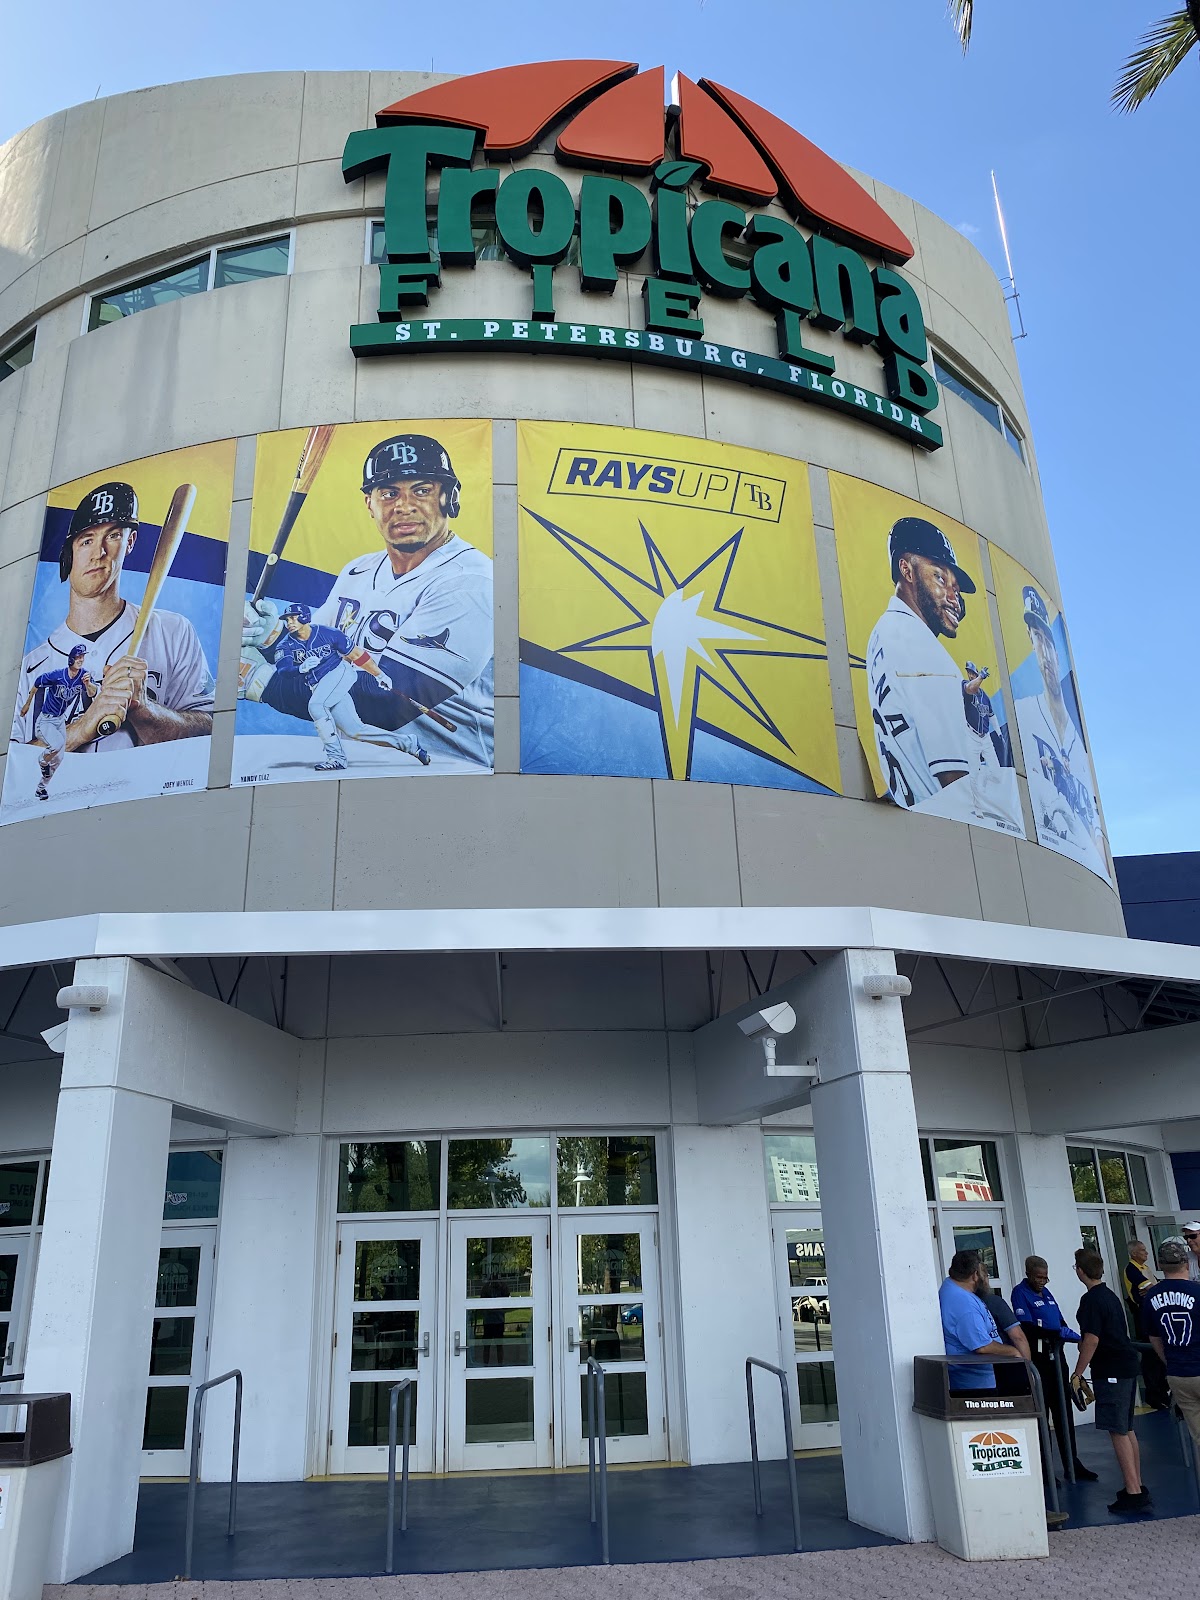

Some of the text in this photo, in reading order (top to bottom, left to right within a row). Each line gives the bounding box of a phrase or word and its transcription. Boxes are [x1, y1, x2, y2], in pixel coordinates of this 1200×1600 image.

[342, 124, 927, 366] Tropicana
[377, 261, 940, 414] FIELD
[395, 321, 923, 433] ST. PETERSBURG, FLORIDA
[386, 441, 418, 465] TB
[90, 490, 114, 515] TB
[743, 481, 773, 511] TB
[1150, 1291, 1195, 1311] MEADOWS
[1160, 1312, 1192, 1346] 17
[964, 1400, 980, 1409] The
[999, 1400, 1015, 1408] Box
[968, 1444, 1020, 1461] Tropicana
[982, 1460, 1014, 1471] FIELD
